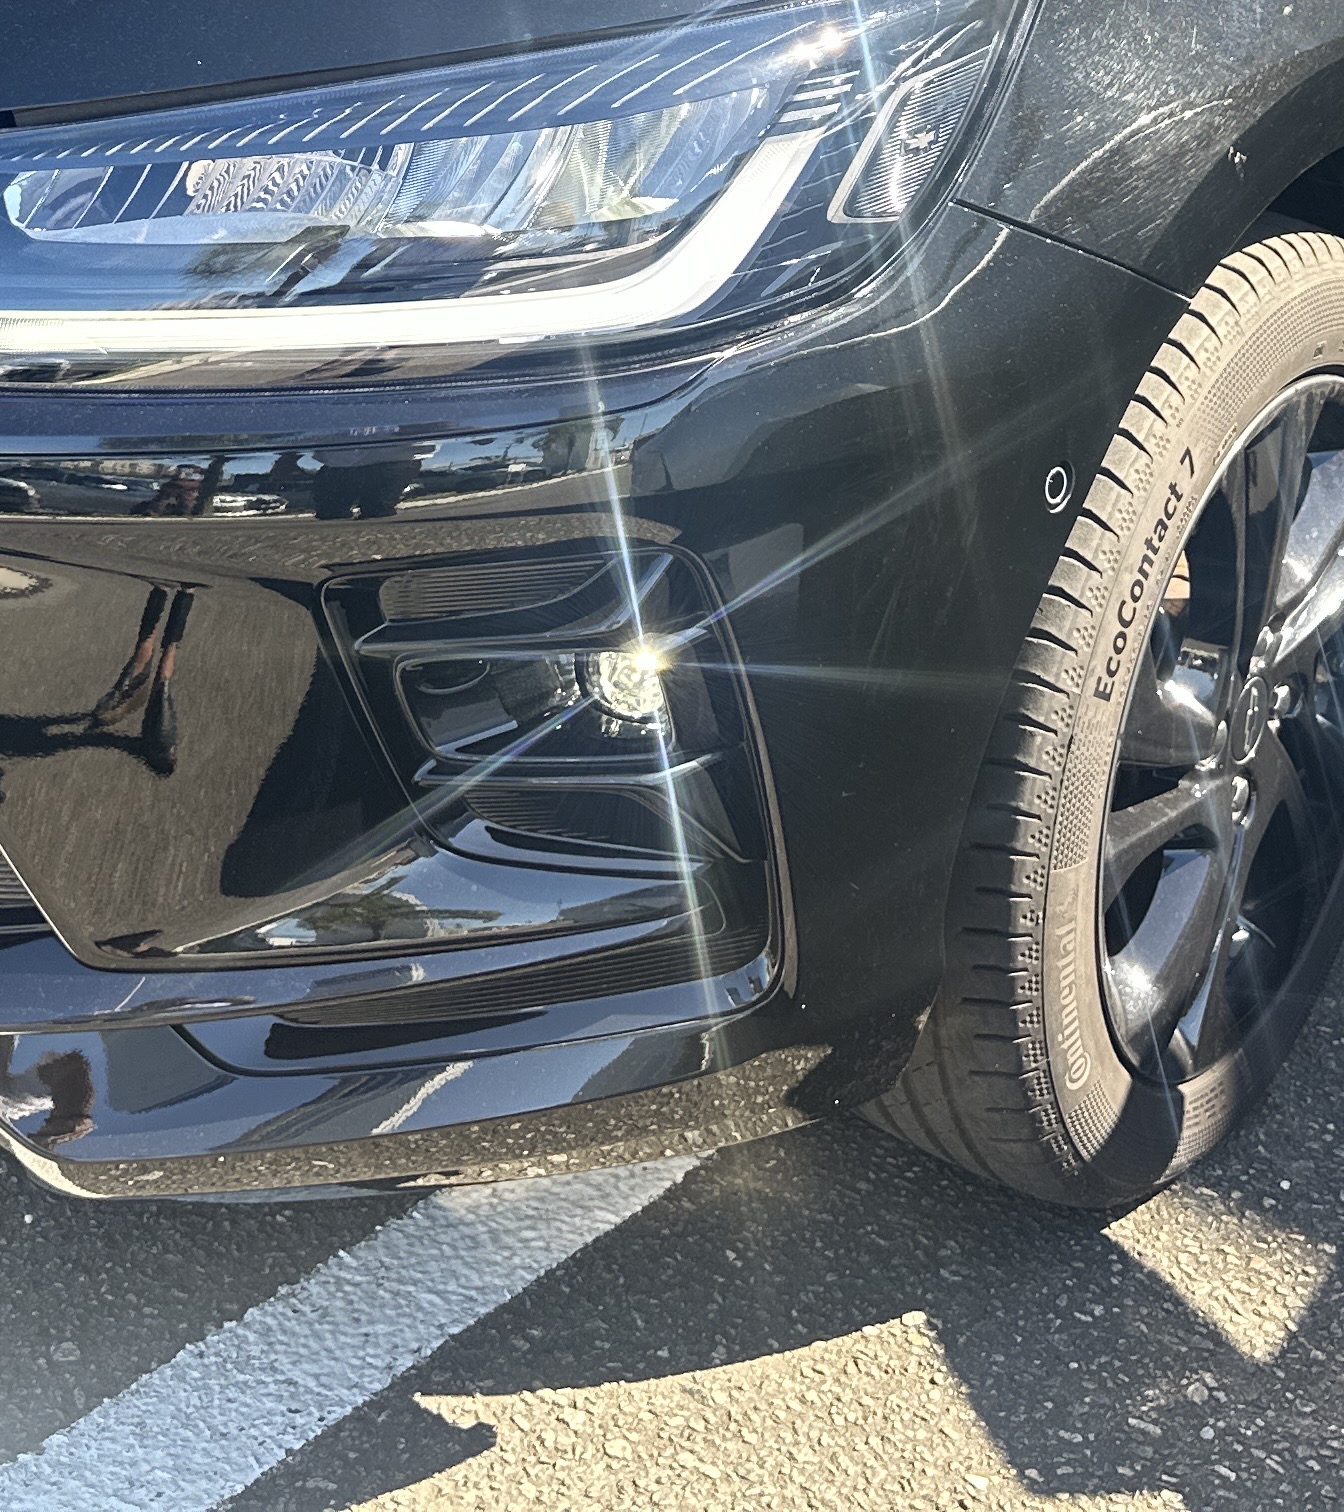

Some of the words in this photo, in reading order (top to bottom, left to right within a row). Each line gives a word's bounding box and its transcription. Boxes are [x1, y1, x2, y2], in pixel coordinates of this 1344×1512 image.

[1093, 481, 1184, 702] EcoContact
[1179, 446, 1195, 479] 7
[1056, 920, 1091, 1090] Continental
